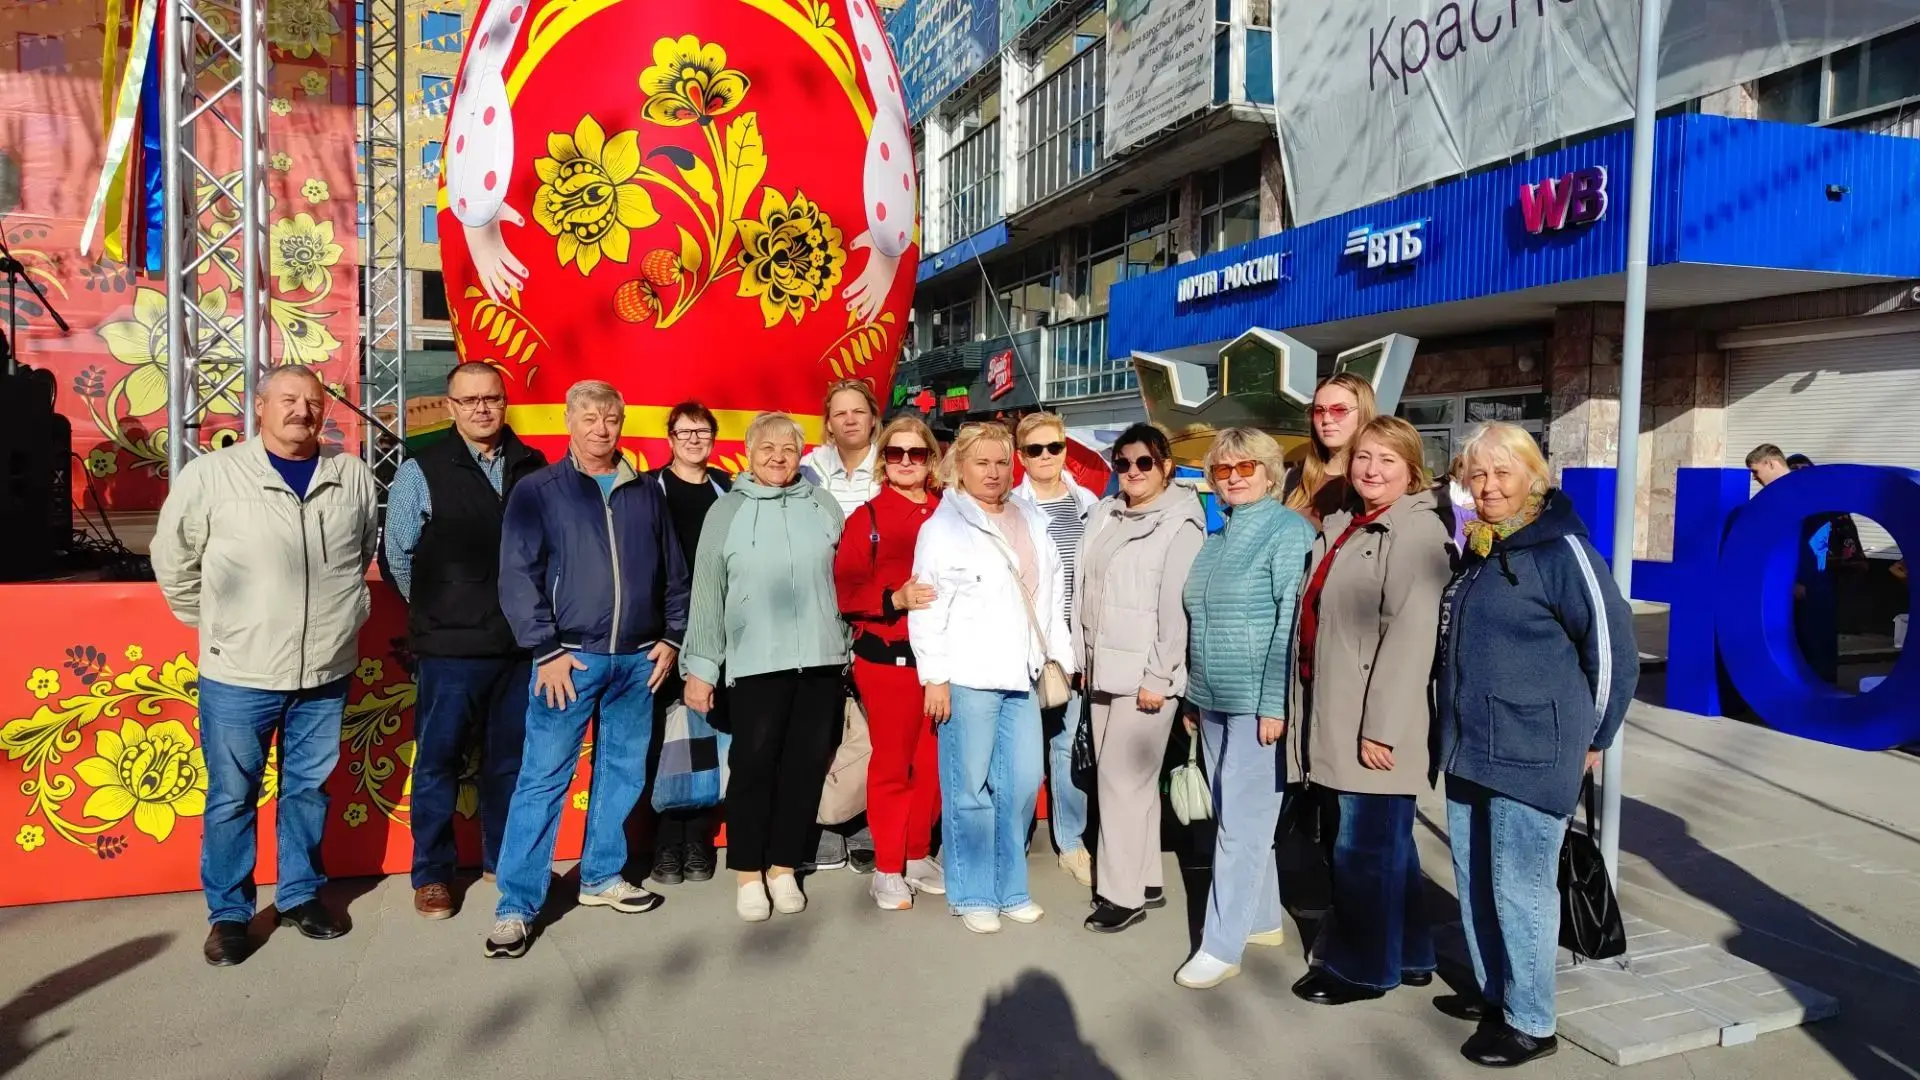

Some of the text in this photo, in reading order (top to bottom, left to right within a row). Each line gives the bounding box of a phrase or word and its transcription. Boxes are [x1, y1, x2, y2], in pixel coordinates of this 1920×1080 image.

[1369, 0, 1575, 95] Крас
[1520, 166, 1608, 234] WB
[1367, 222, 1422, 268] ВТБ
[1178, 253, 1279, 302] ПОЧТА РОССИИ
